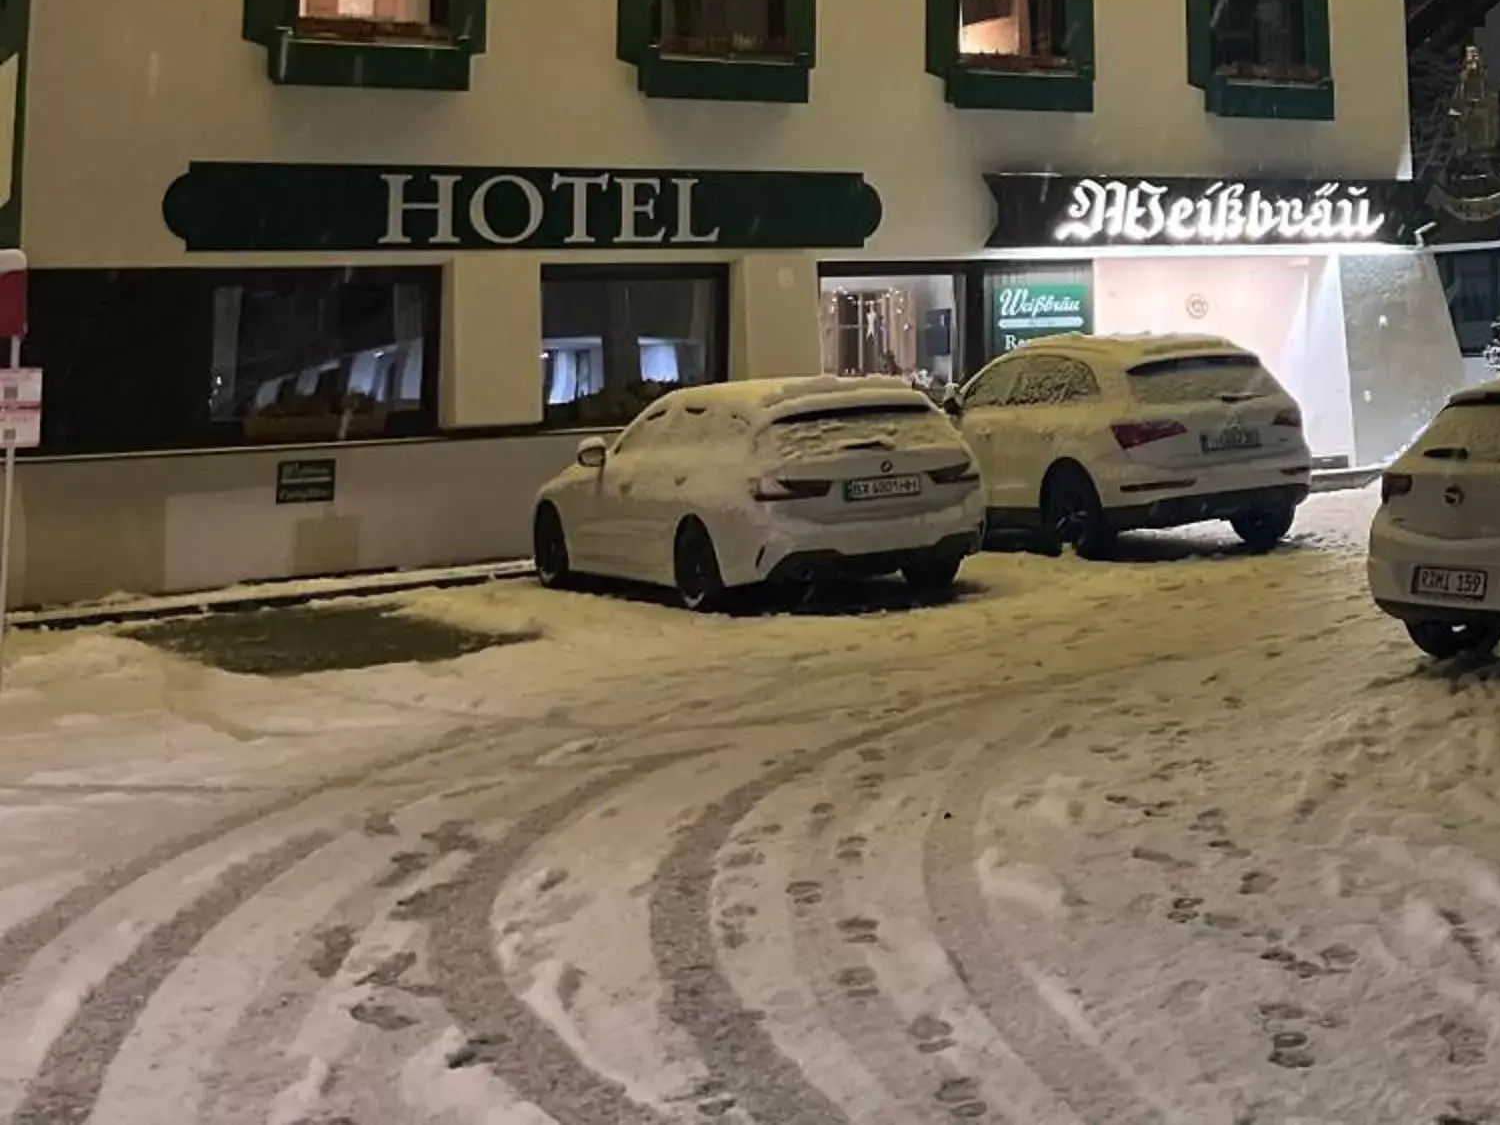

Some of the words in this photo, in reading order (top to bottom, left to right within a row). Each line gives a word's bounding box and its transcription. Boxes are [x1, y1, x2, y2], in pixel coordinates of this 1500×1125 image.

[377, 173, 720, 244] HOTEL
[1054, 178, 1385, 242] Weißbräu
[999, 288, 1081, 317] Weißbräu
